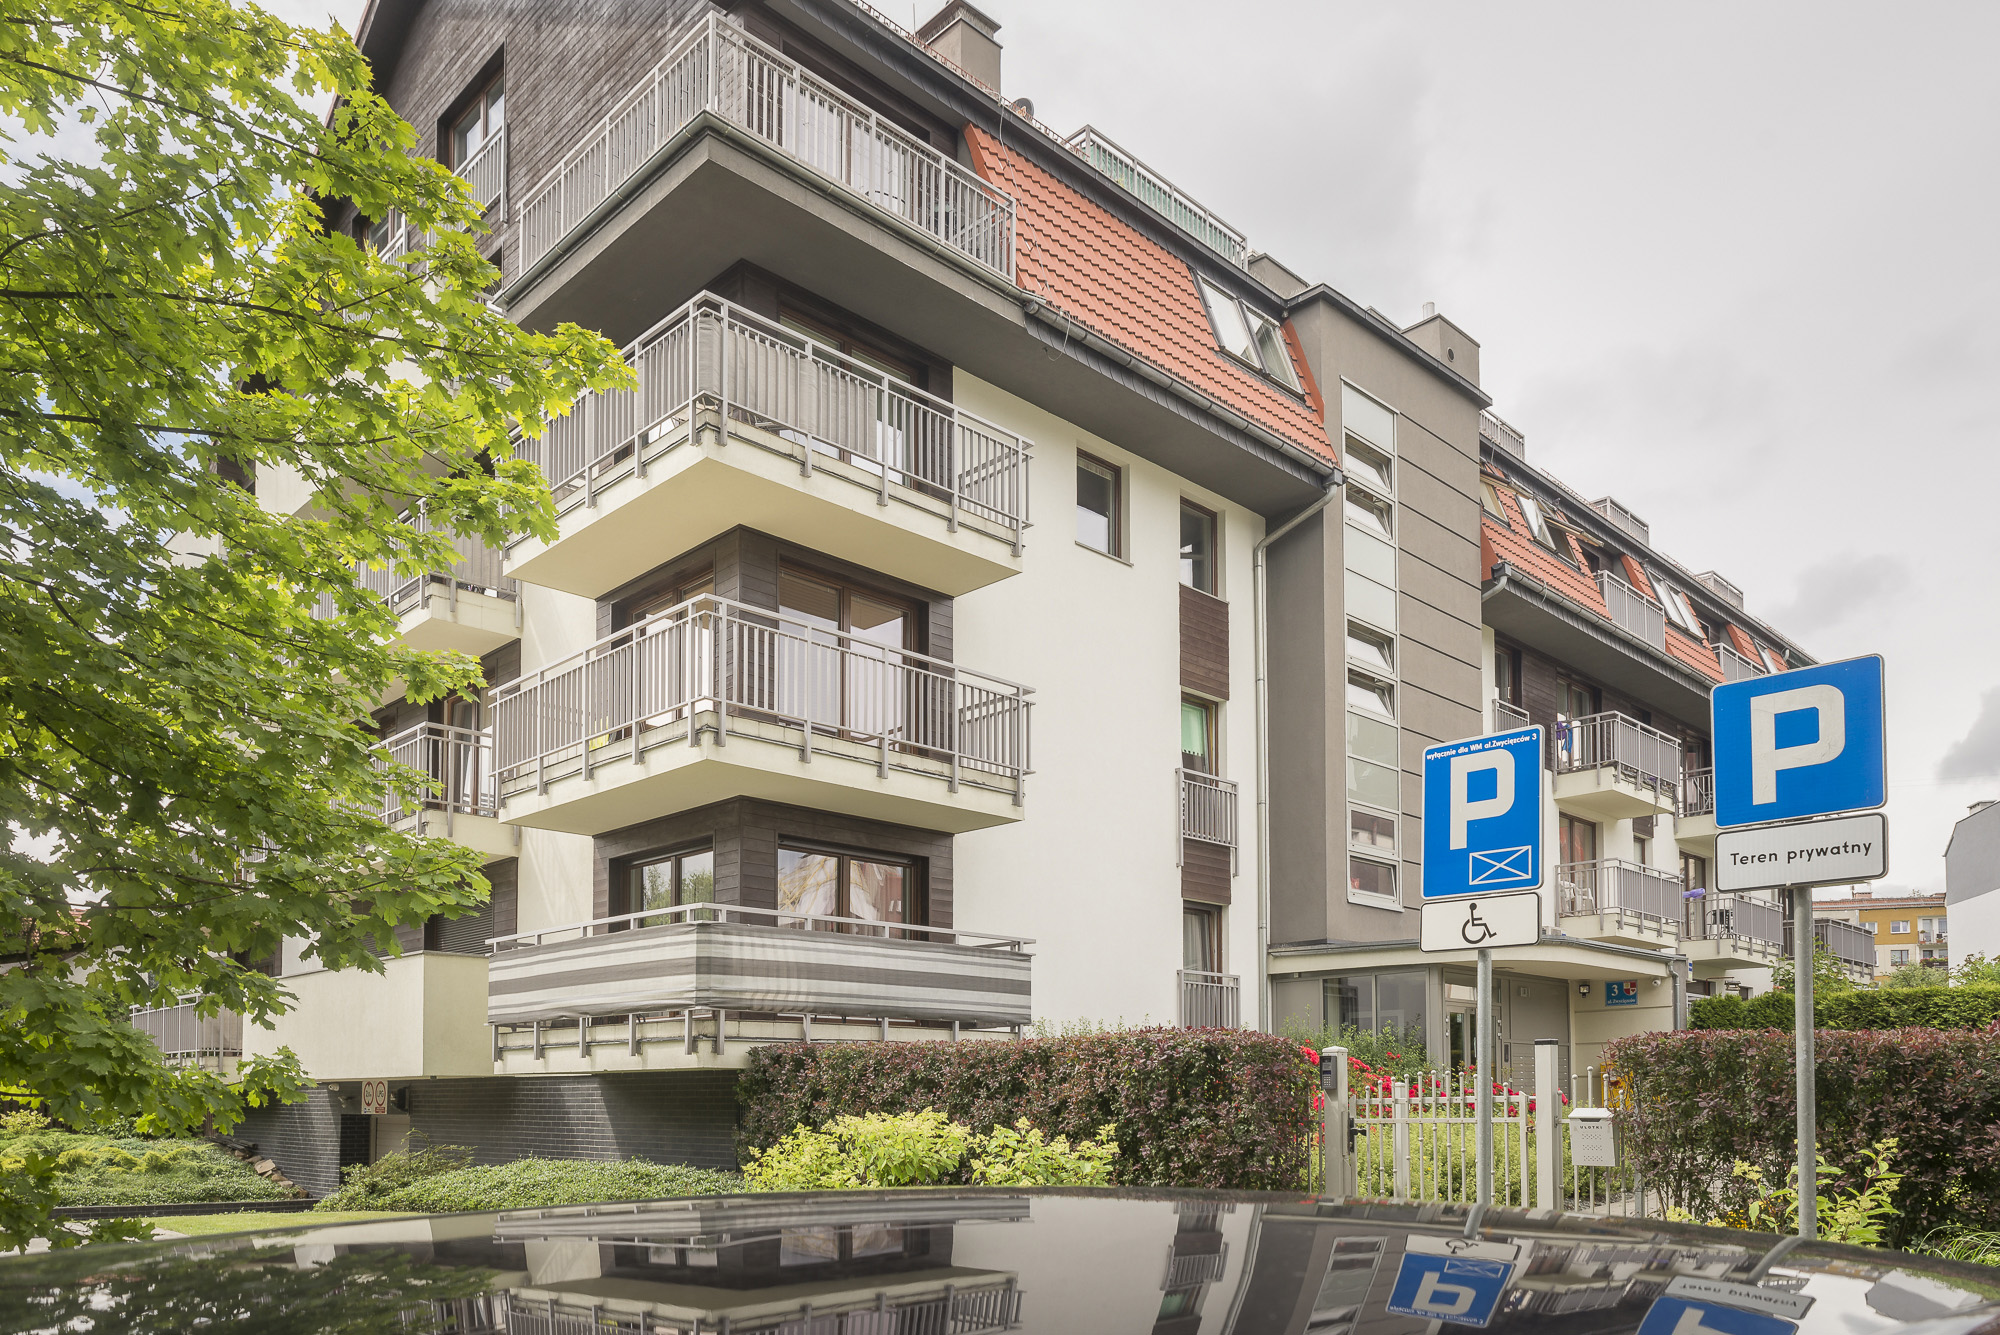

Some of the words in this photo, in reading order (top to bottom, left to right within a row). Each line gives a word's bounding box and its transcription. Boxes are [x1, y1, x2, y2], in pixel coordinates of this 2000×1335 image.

[1426, 748, 1456, 761] wyłącznie
[1457, 746, 1469, 755] dla
[1470, 742, 1482, 752] WM
[1532, 732, 1538, 741] 3
[1750, 684, 1846, 806] P
[1450, 748, 1515, 850] P
[1730, 850, 1778, 866] Teren
[1787, 840, 1872, 864] prywatny
[1611, 984, 1619, 997] 3
